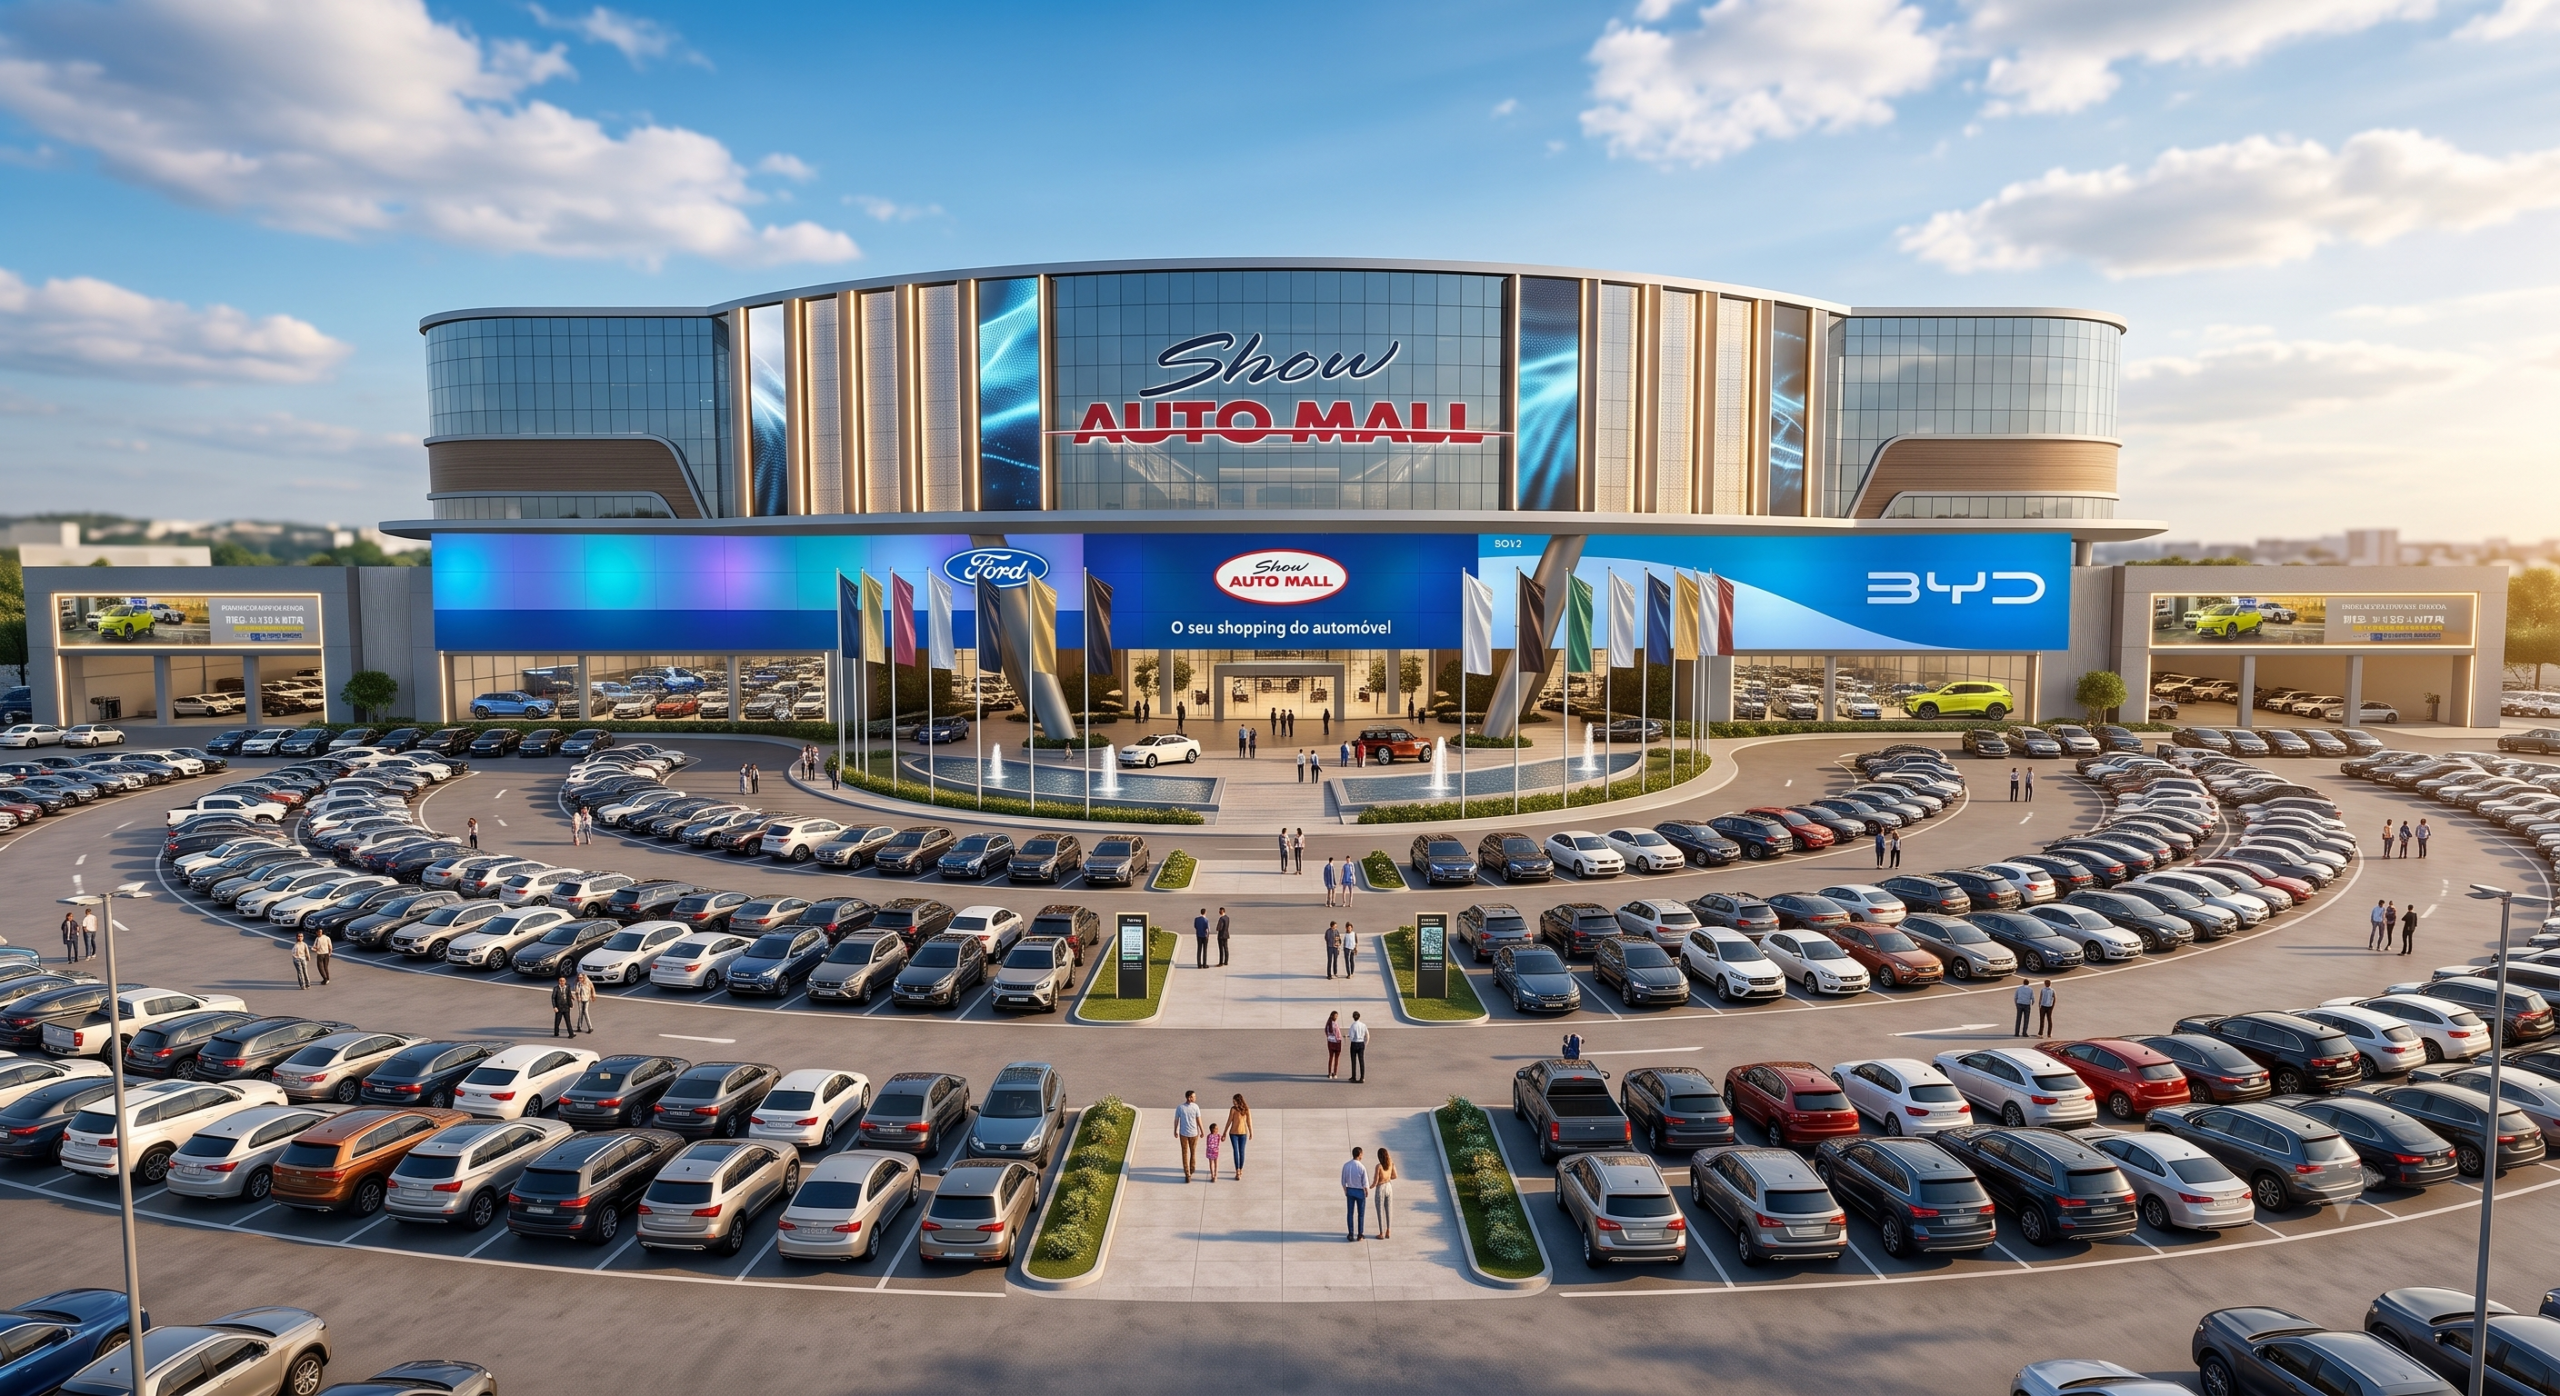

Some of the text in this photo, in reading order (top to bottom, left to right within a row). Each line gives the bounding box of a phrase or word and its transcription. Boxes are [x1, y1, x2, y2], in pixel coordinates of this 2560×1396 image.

[1138, 331, 1401, 398] Show
[1072, 400, 1486, 444] AUTO MALL
[964, 553, 1028, 580] Ford
[1252, 559, 1309, 575] Show
[1229, 575, 1333, 587] AUTO MALL
[1867, 571, 2046, 605] BYD
[1171, 620, 1391, 638] O seu shopping do automóvel
